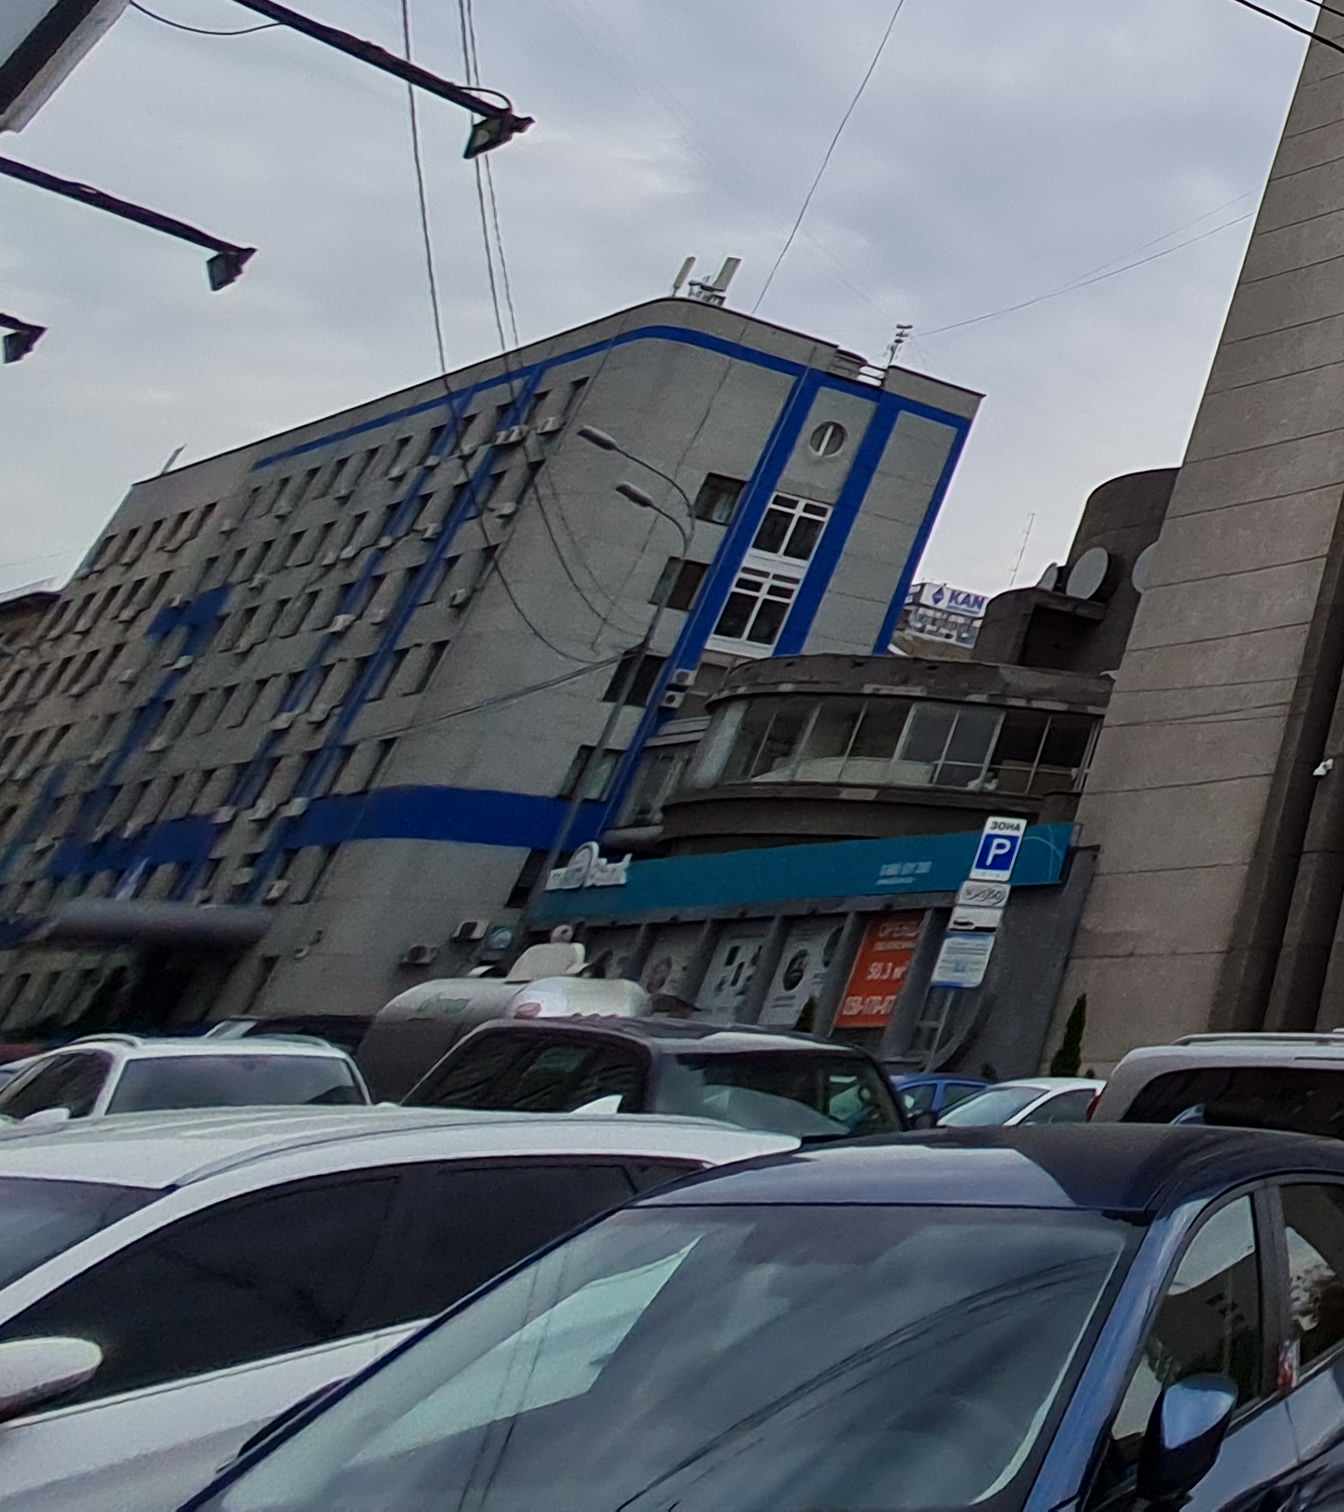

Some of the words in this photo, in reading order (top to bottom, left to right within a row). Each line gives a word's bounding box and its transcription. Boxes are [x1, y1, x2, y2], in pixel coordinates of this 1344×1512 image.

[949, 590, 985, 609] KAN
[990, 821, 1021, 832] ЗОНА
[986, 838, 1012, 866] P
